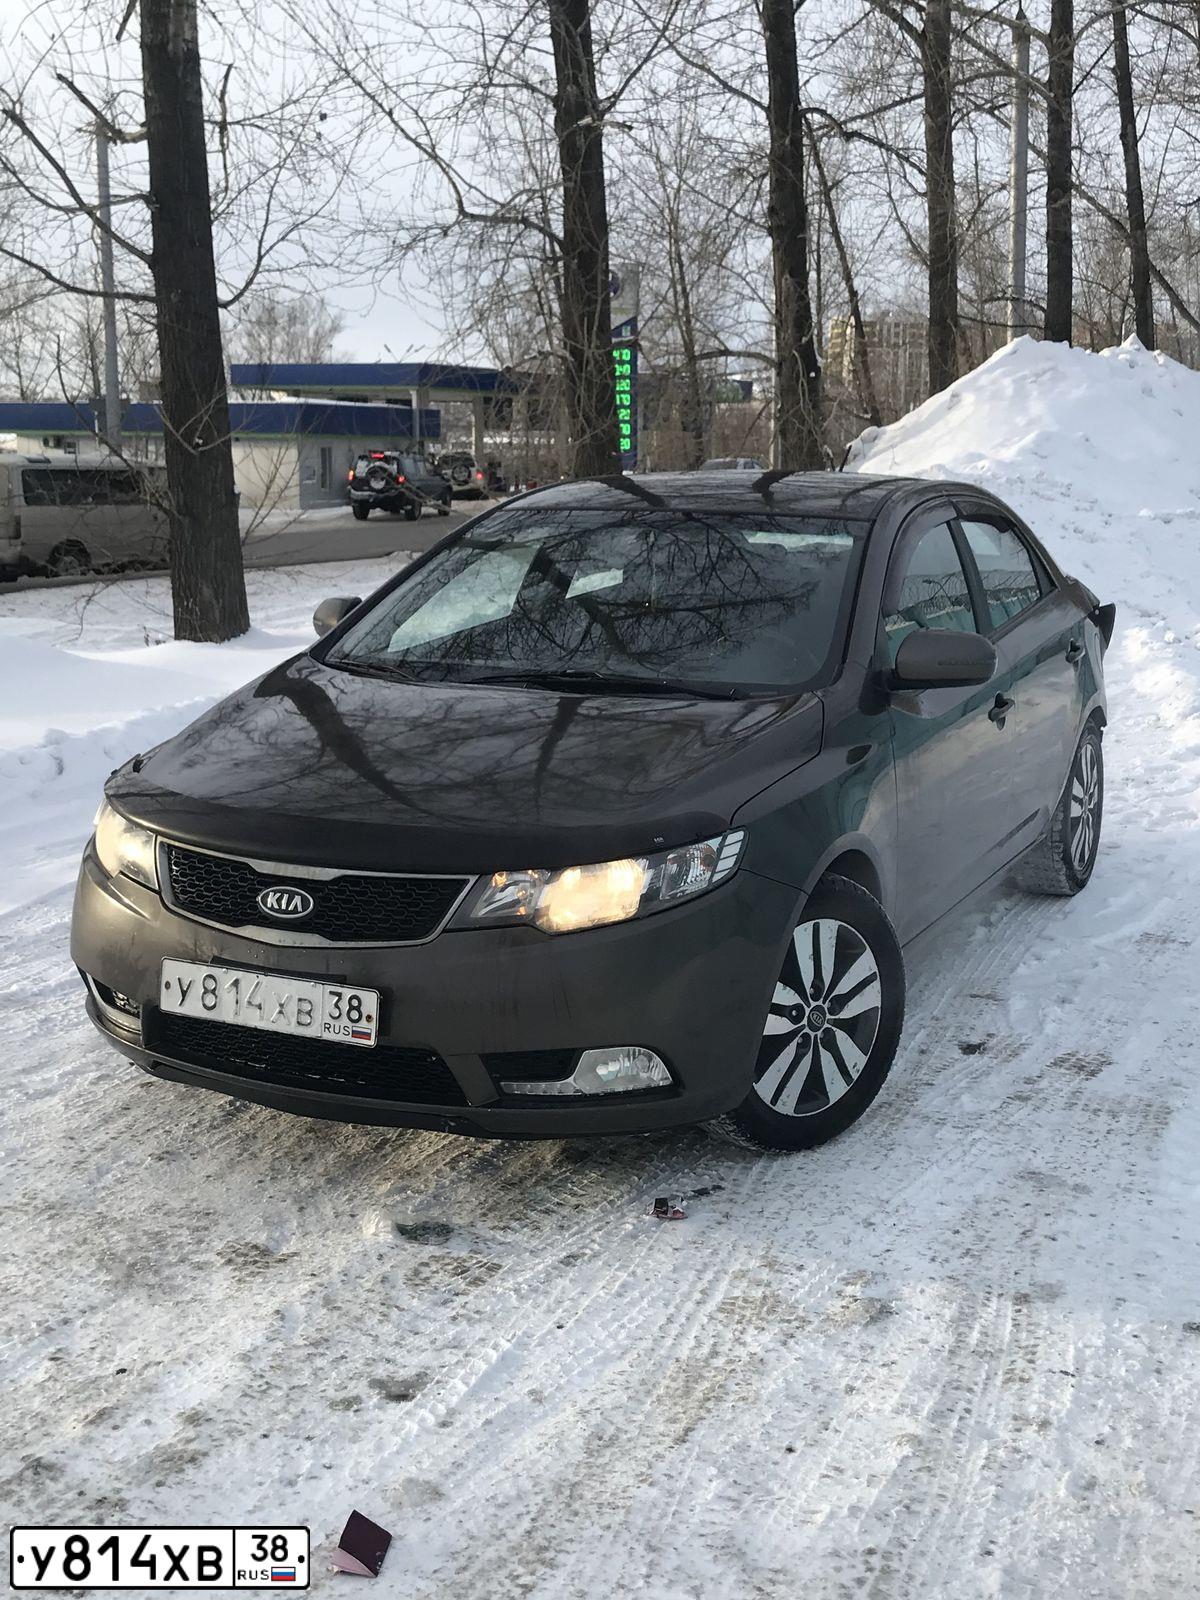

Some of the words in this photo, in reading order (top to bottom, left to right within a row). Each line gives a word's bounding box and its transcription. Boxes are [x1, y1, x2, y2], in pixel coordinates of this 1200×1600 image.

[267, 891, 303, 912] KIA
[328, 990, 363, 1024] 38
[323, 1022, 351, 1036] RUS
